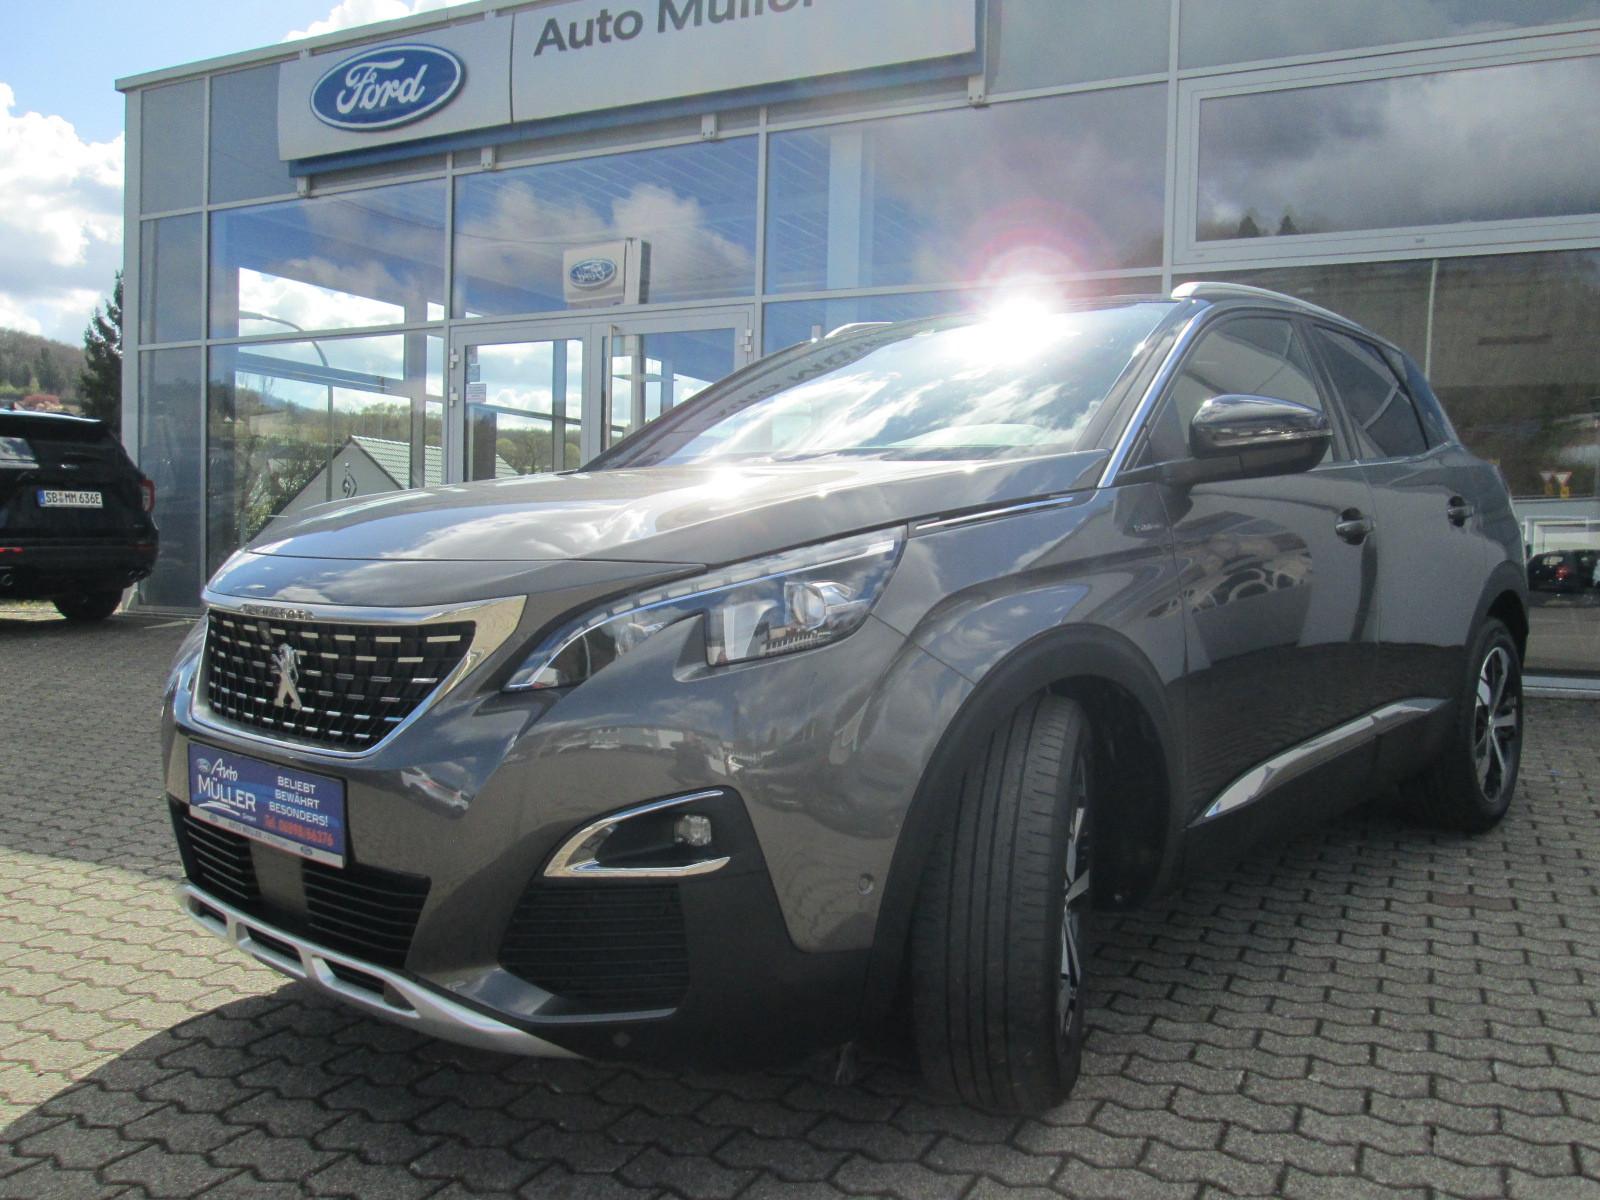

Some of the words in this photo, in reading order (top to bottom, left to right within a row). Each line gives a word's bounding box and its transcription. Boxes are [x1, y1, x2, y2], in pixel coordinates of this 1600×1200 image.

[532, 9, 644, 56] Auto
[336, 57, 429, 114] Ford
[210, 757, 238, 782] Auto
[197, 773, 257, 813] MÜLLER
[277, 775, 317, 795] BELIEBT
[274, 788, 321, 810] BEWÄHRT
[268, 801, 330, 828] BESONDERS!
